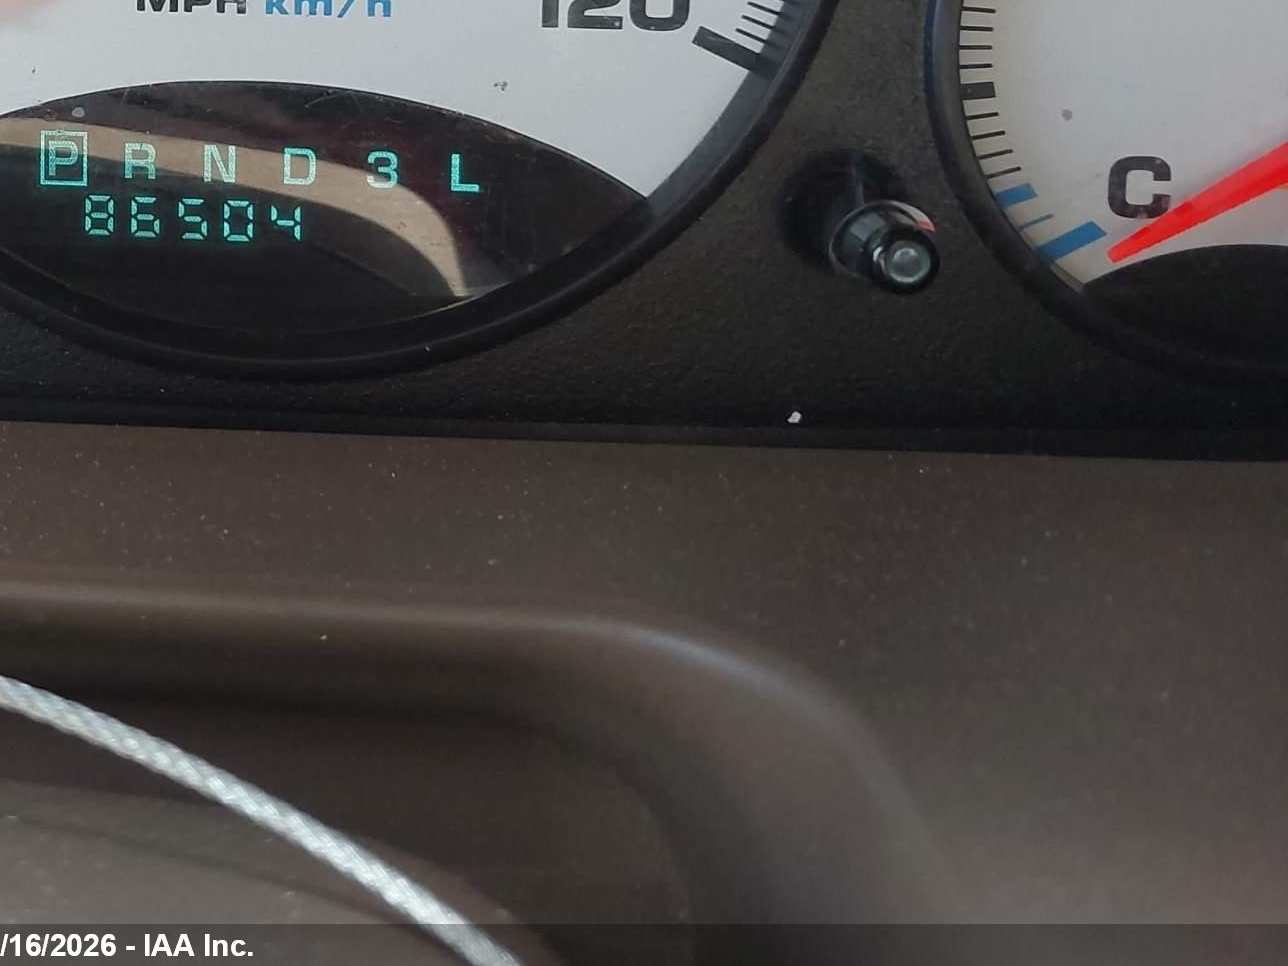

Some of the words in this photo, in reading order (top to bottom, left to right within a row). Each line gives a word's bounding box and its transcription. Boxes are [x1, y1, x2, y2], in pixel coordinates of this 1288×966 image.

[48, 140, 78, 177] P
[123, 142, 156, 180] R
[202, 144, 237, 184] N
[282, 147, 317, 186] D
[366, 150, 399, 190] 3
[450, 153, 480, 193] L
[1107, 154, 1173, 220] C
[83, 194, 303, 243] 86504
